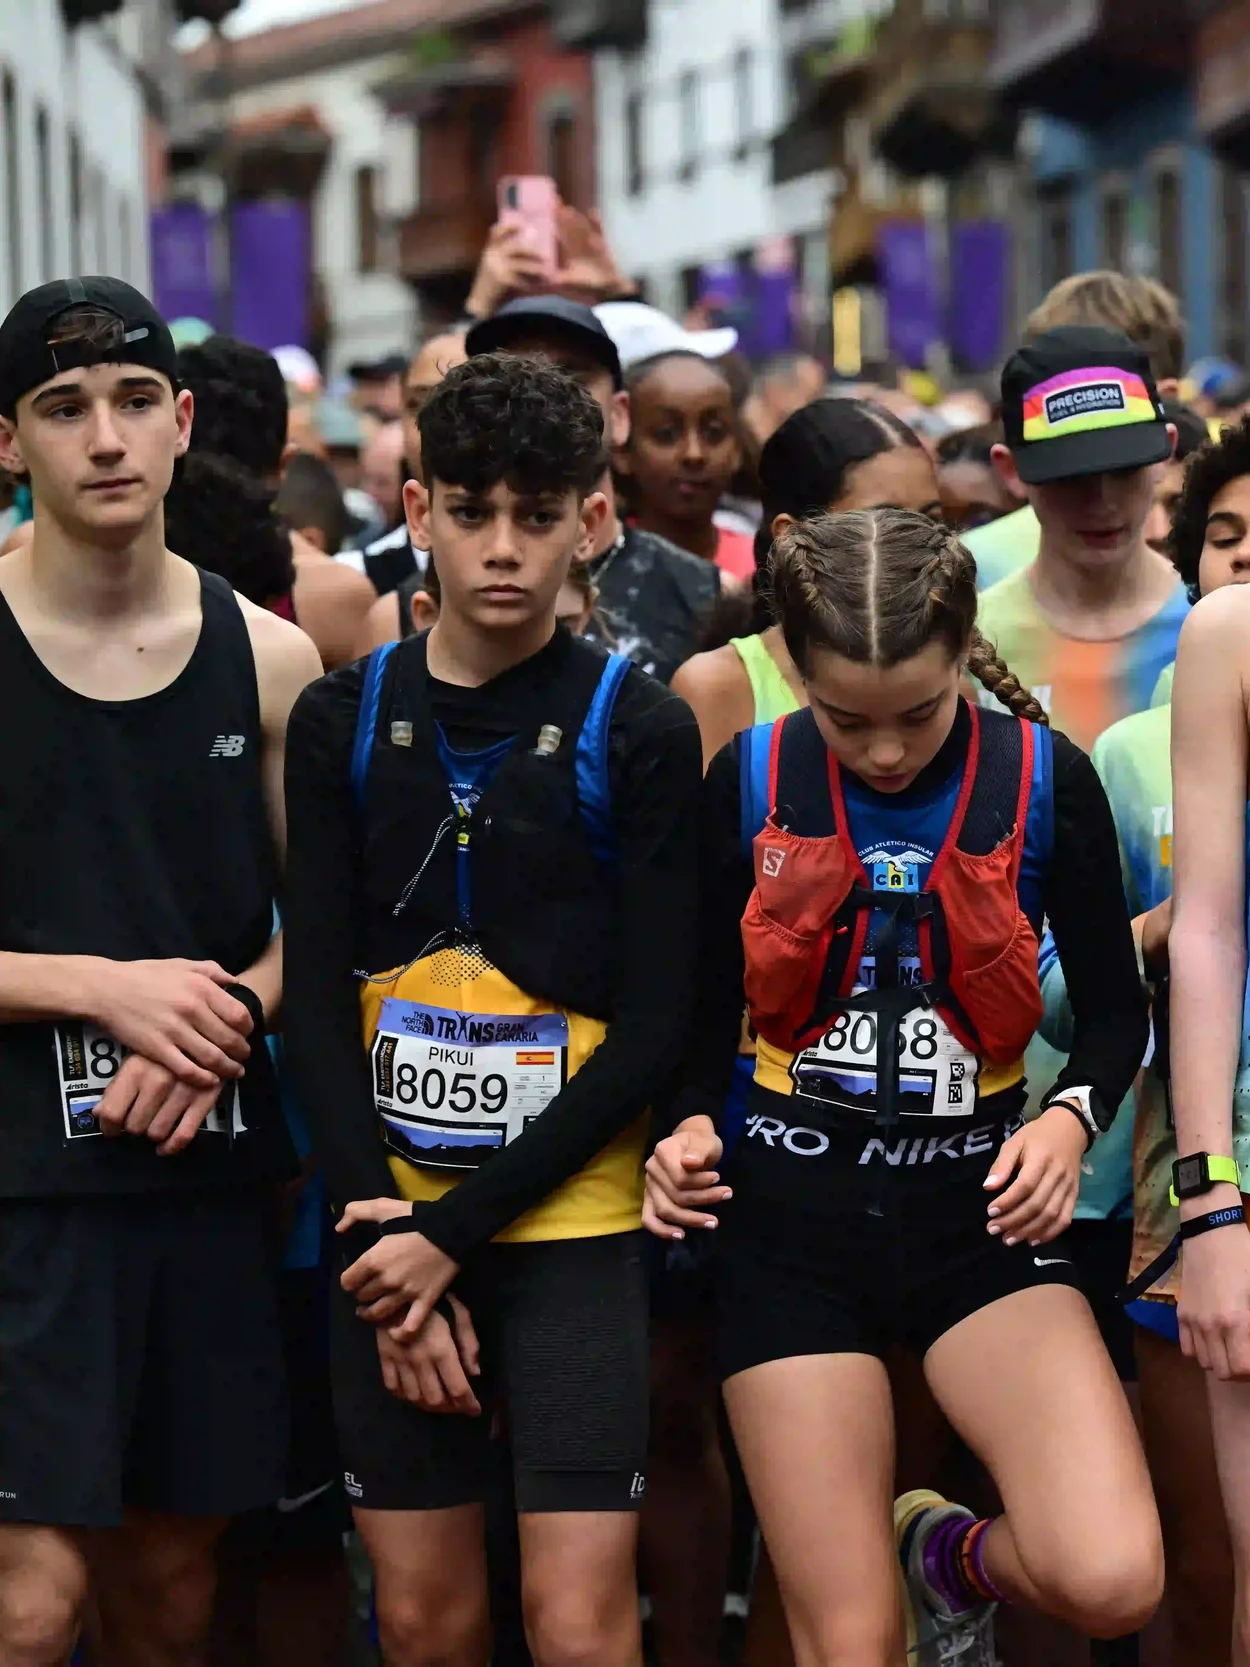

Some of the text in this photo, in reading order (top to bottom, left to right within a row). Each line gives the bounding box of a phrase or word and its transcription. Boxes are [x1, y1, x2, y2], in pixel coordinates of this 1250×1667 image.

[1049, 388, 1119, 413] PRECISION
[858, 846, 874, 857] CLUB
[908, 842, 934, 857] INSULAR
[402, 1016, 425, 1027] NORTH
[413, 1011, 425, 1019] THE
[405, 1025, 422, 1034] FACE
[437, 1012, 495, 1043] TRANS
[497, 1022, 525, 1033] GRAN
[494, 1031, 539, 1042] CANARIA
[90, 1038, 119, 1079] 8
[428, 1046, 474, 1066] PIKUI
[396, 1063, 508, 1114] 8059
[746, 1113, 830, 1156] RO
[858, 1124, 995, 1166] NIKE
